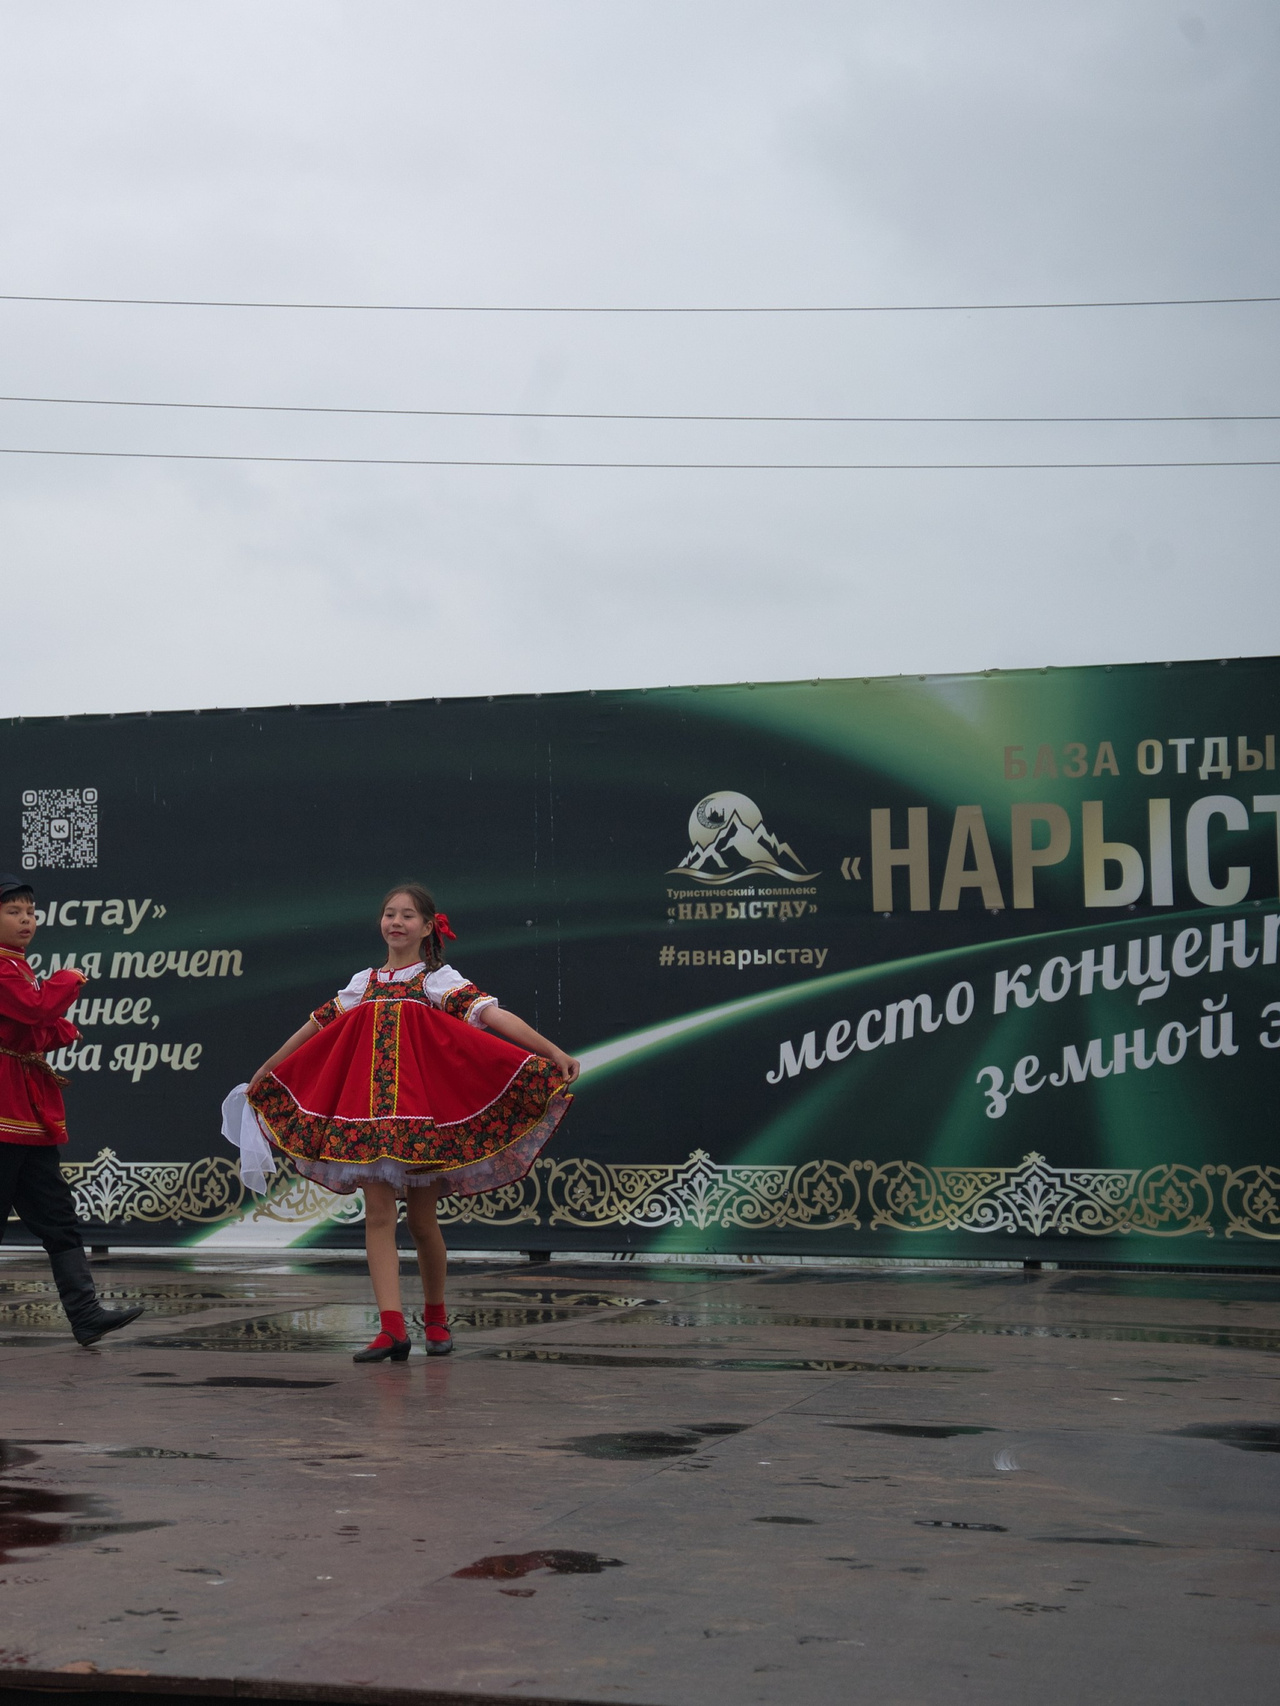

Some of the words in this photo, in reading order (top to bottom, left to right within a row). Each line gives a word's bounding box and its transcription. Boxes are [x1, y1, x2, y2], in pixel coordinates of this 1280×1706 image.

[1004, 741, 1120, 780] БАЗА
[1137, 734, 1276, 780] ОТДЫ
[667, 886, 755, 899] Туристический
[758, 887, 817, 896] комплекс
[667, 901, 818, 920] «НАРЫСТАУ»
[110, 949, 243, 979] течет
[659, 945, 828, 970] #явнарыстау
[765, 981, 975, 1084] место
[109, 1041, 203, 1083] ярче
[975, 994, 1239, 1119] земной
